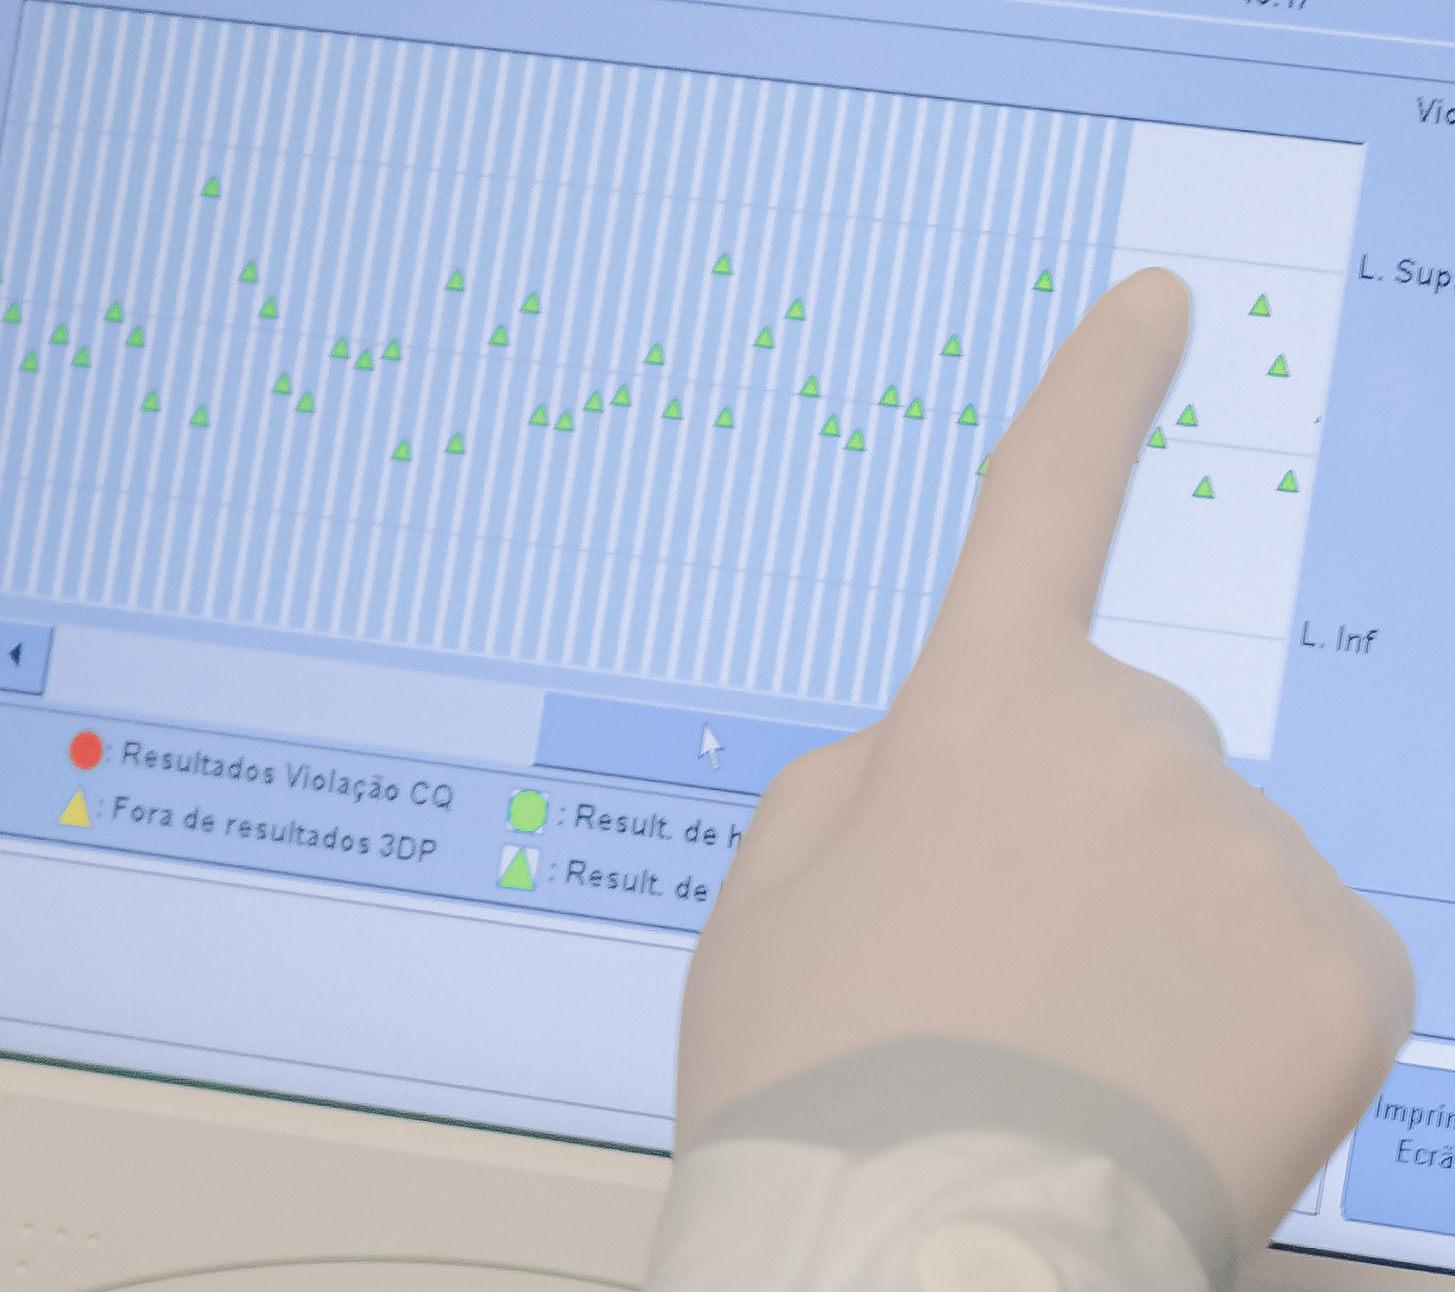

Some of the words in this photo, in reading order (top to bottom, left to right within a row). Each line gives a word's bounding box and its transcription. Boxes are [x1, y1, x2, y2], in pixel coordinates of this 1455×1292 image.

[1357, 253, 1384, 282] L.
[1299, 620, 1327, 650] L.
[1336, 623, 1381, 655] Inf
[120, 739, 276, 786] Resultados
[286, 761, 402, 805] Violação
[409, 779, 456, 812] CQ
[111, 794, 174, 829] Fora
[182, 806, 217, 834] de
[224, 816, 372, 856] resultados
[378, 831, 439, 863] 3DP
[572, 802, 674, 841] Result.
[683, 818, 719, 847] de
[564, 858, 665, 898] Result.
[675, 875, 711, 903] de
[1395, 1139, 1455, 1172] Ecrã
